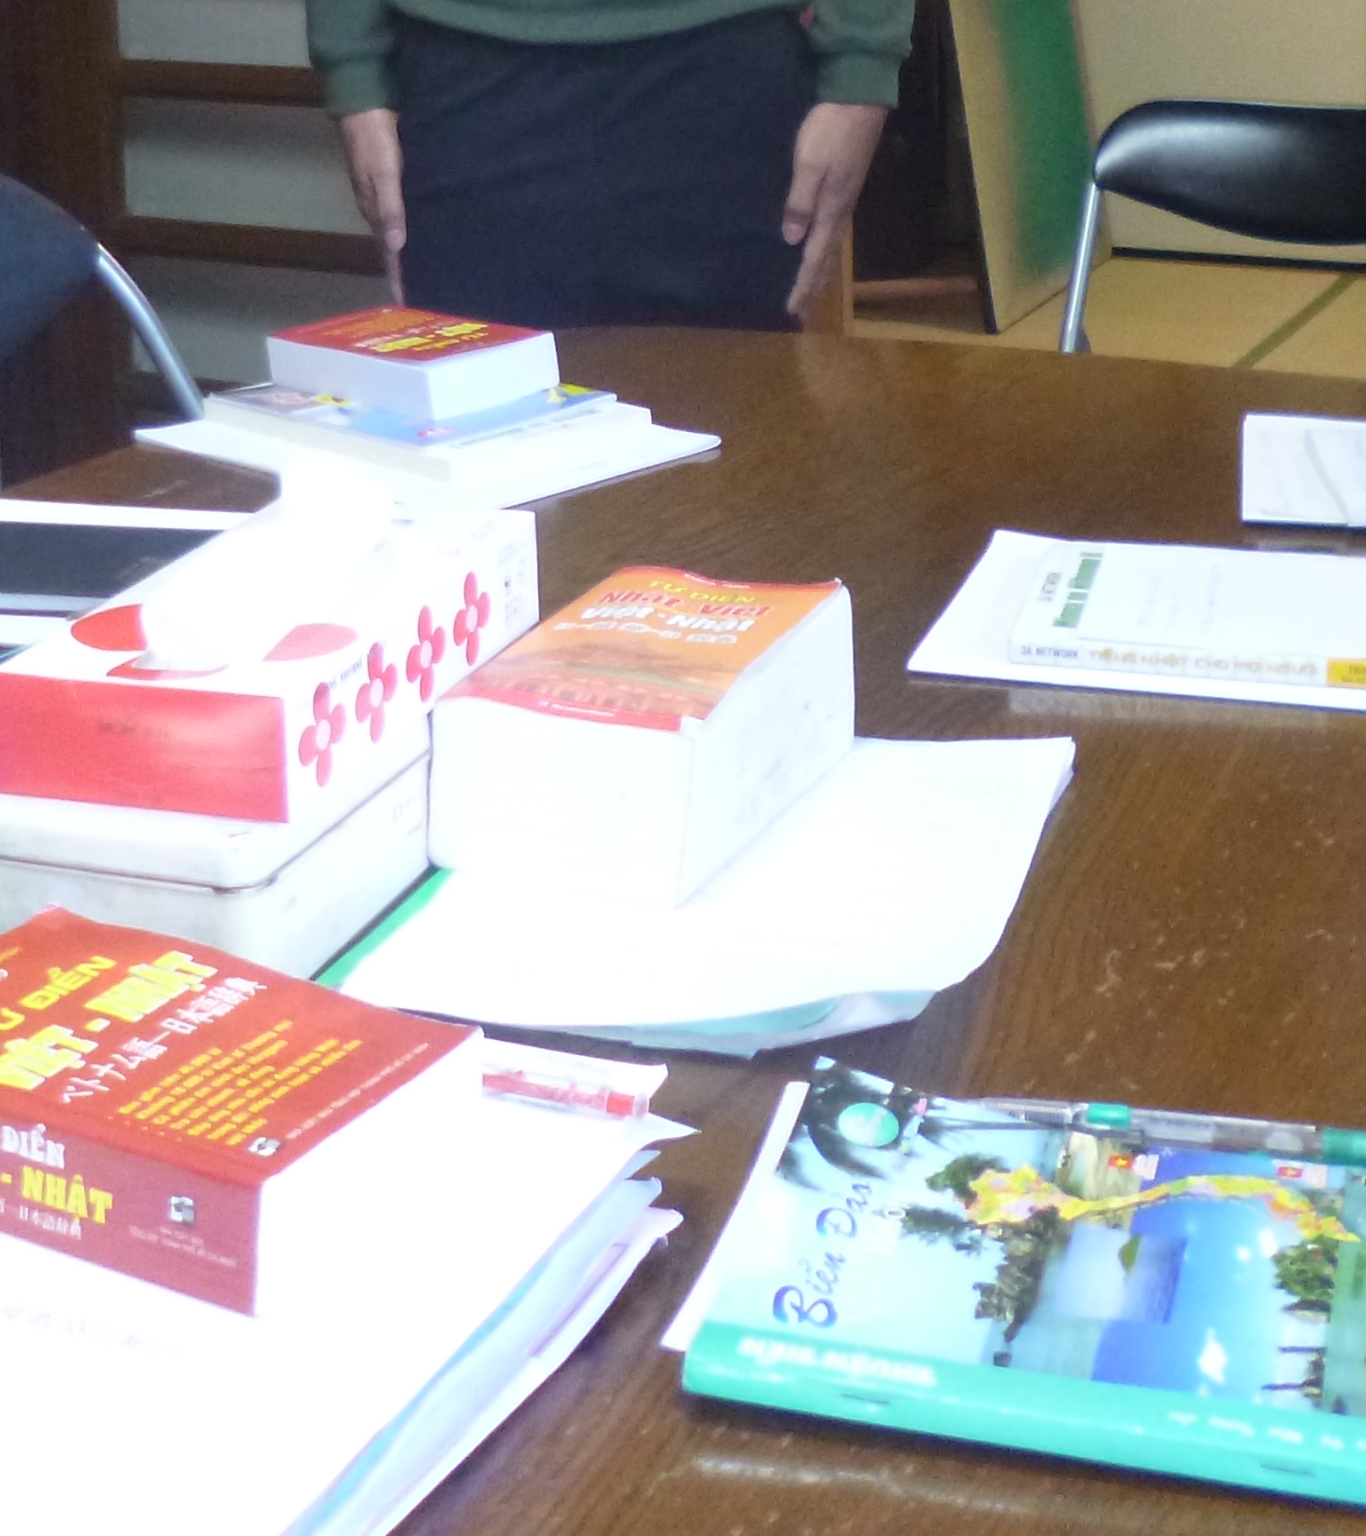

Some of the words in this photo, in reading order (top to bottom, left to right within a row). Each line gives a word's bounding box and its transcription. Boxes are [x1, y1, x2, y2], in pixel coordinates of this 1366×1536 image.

[1035, 647, 1078, 660] NETWORK
[18, 953, 119, 1012] ĐIỂN
[102, 950, 221, 1022] NHẬT
[21, 1165, 115, 1225] NHẬT
[771, 1246, 851, 1330] Biển
[815, 1179, 875, 1242] Đảo
